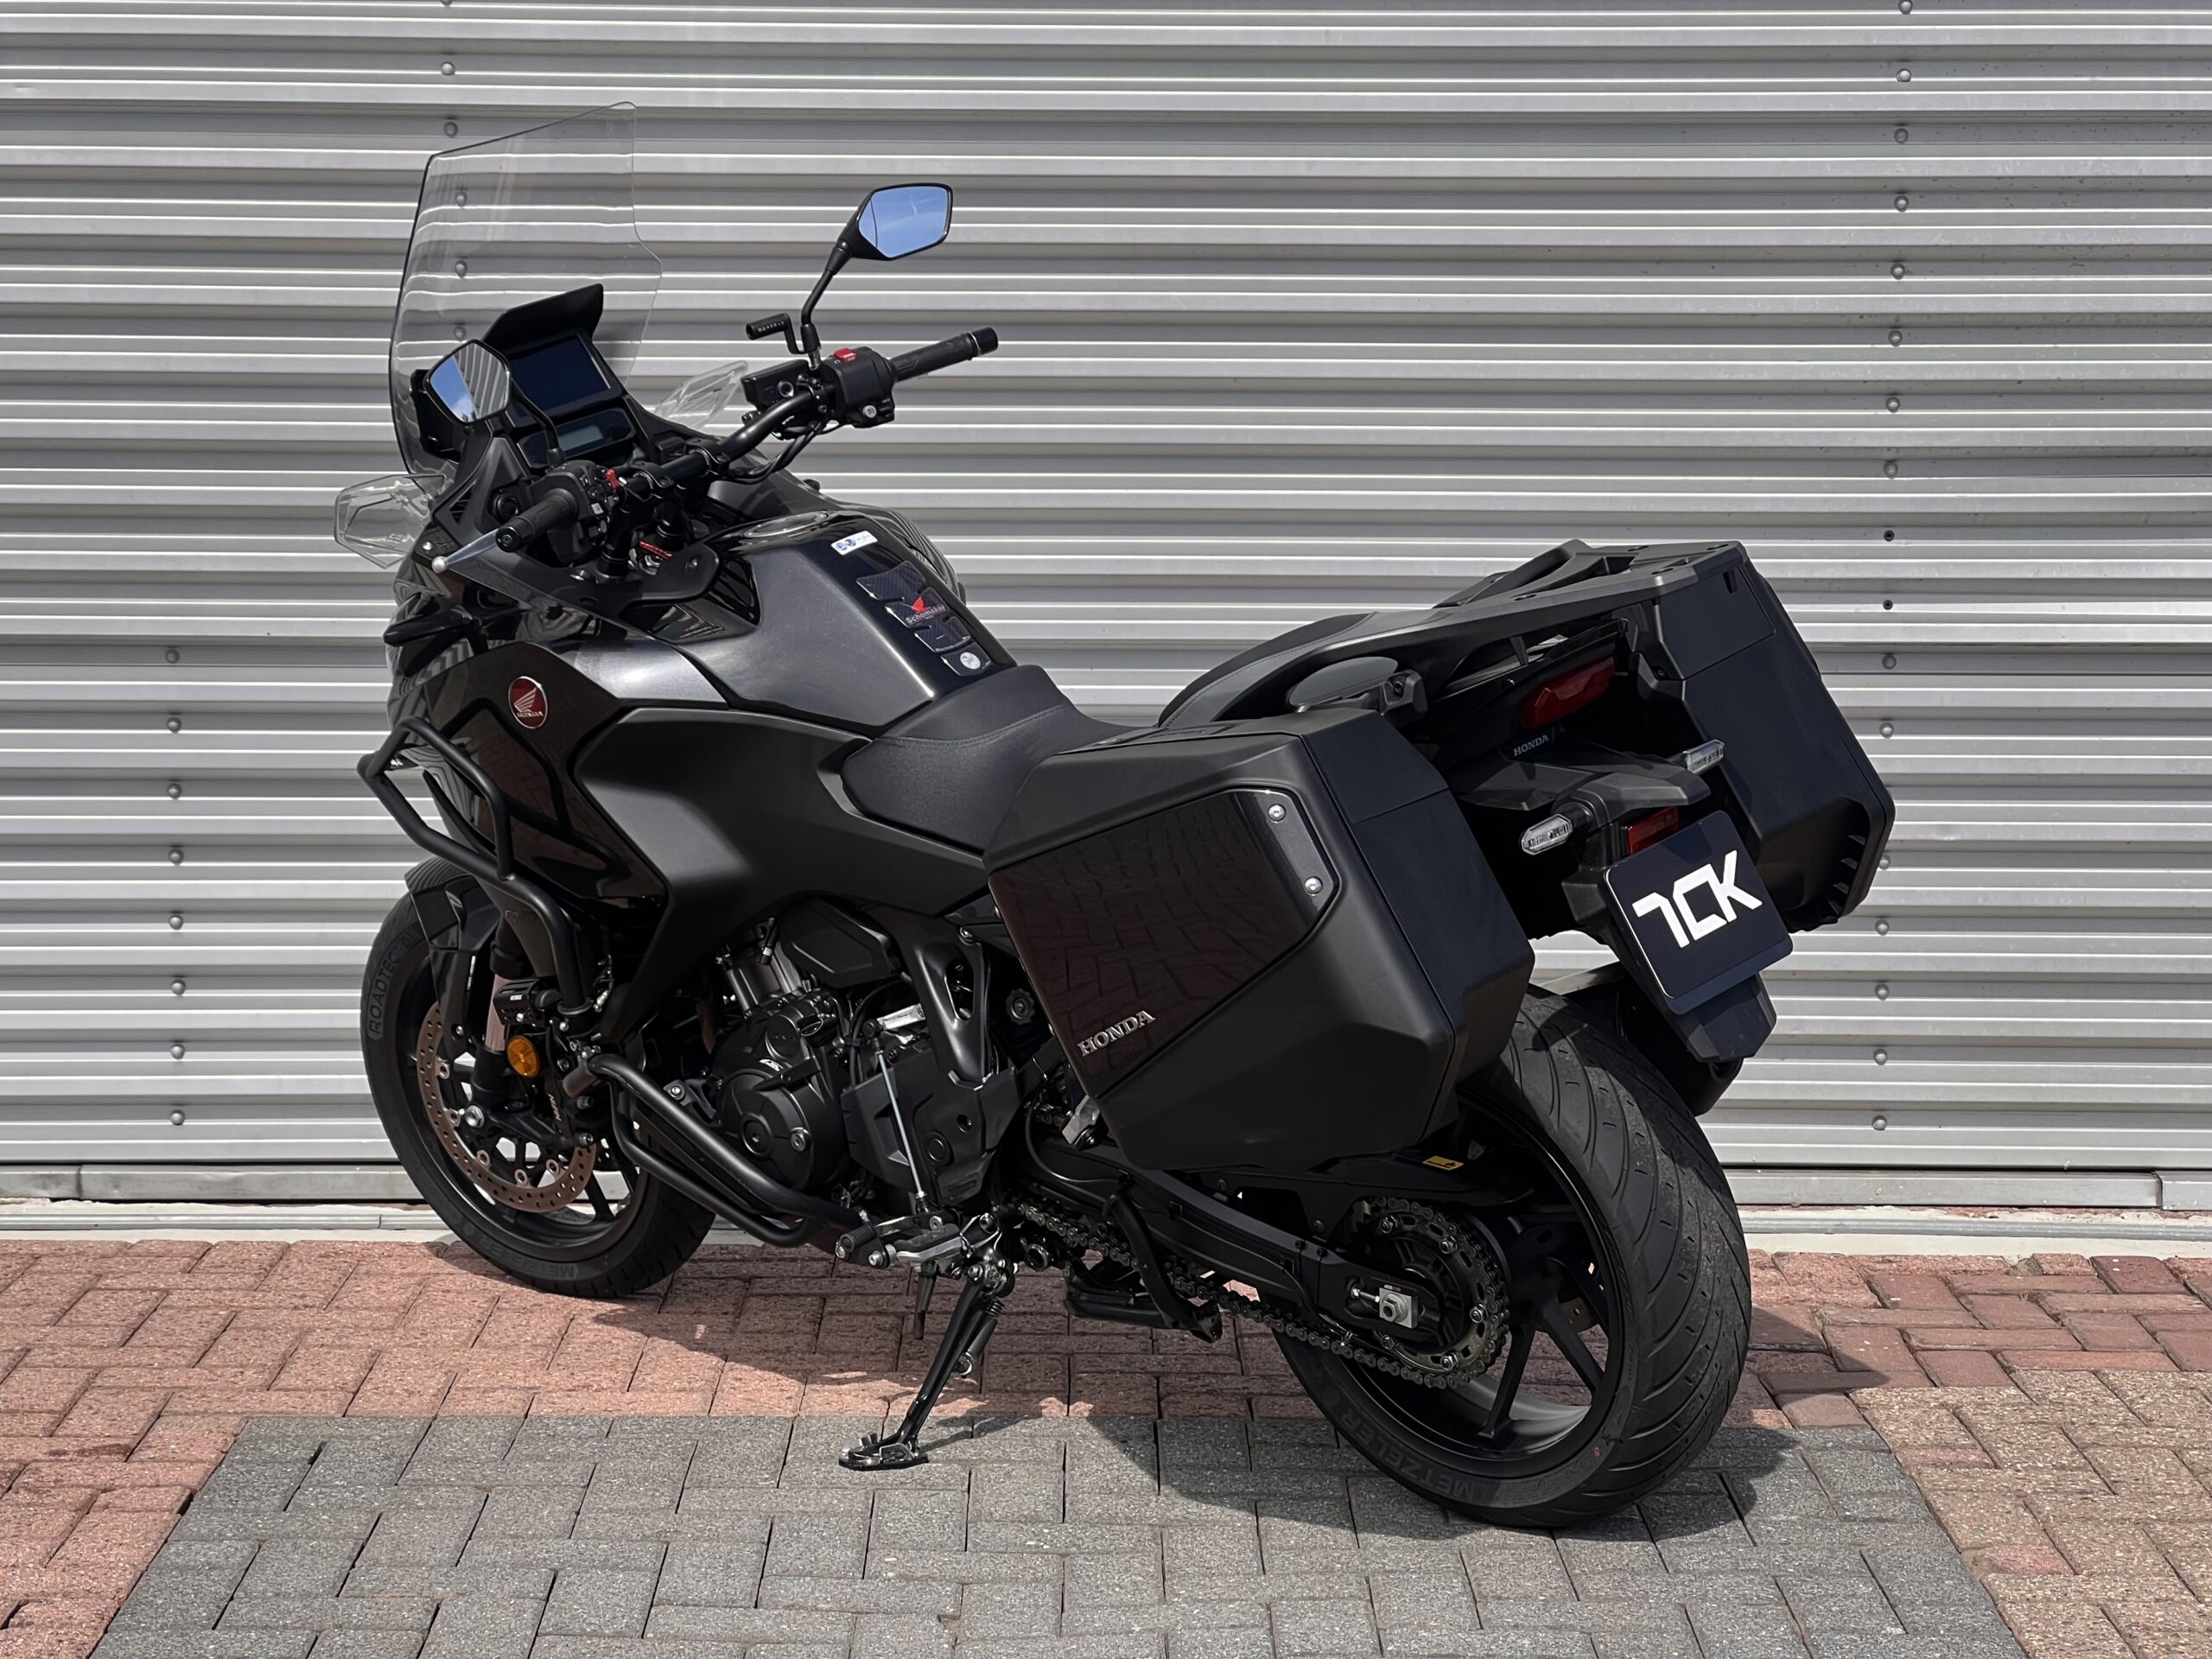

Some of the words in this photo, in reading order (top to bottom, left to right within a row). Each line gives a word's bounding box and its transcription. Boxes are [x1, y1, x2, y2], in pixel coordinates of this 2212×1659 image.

[905, 605, 946, 624] Schomaker
[1513, 734, 1549, 757] HONDA
[368, 945, 399, 1034] ROADTEC
[1077, 1010, 1156, 1057] HONDA
[1341, 1408, 1475, 1497] METZELER
